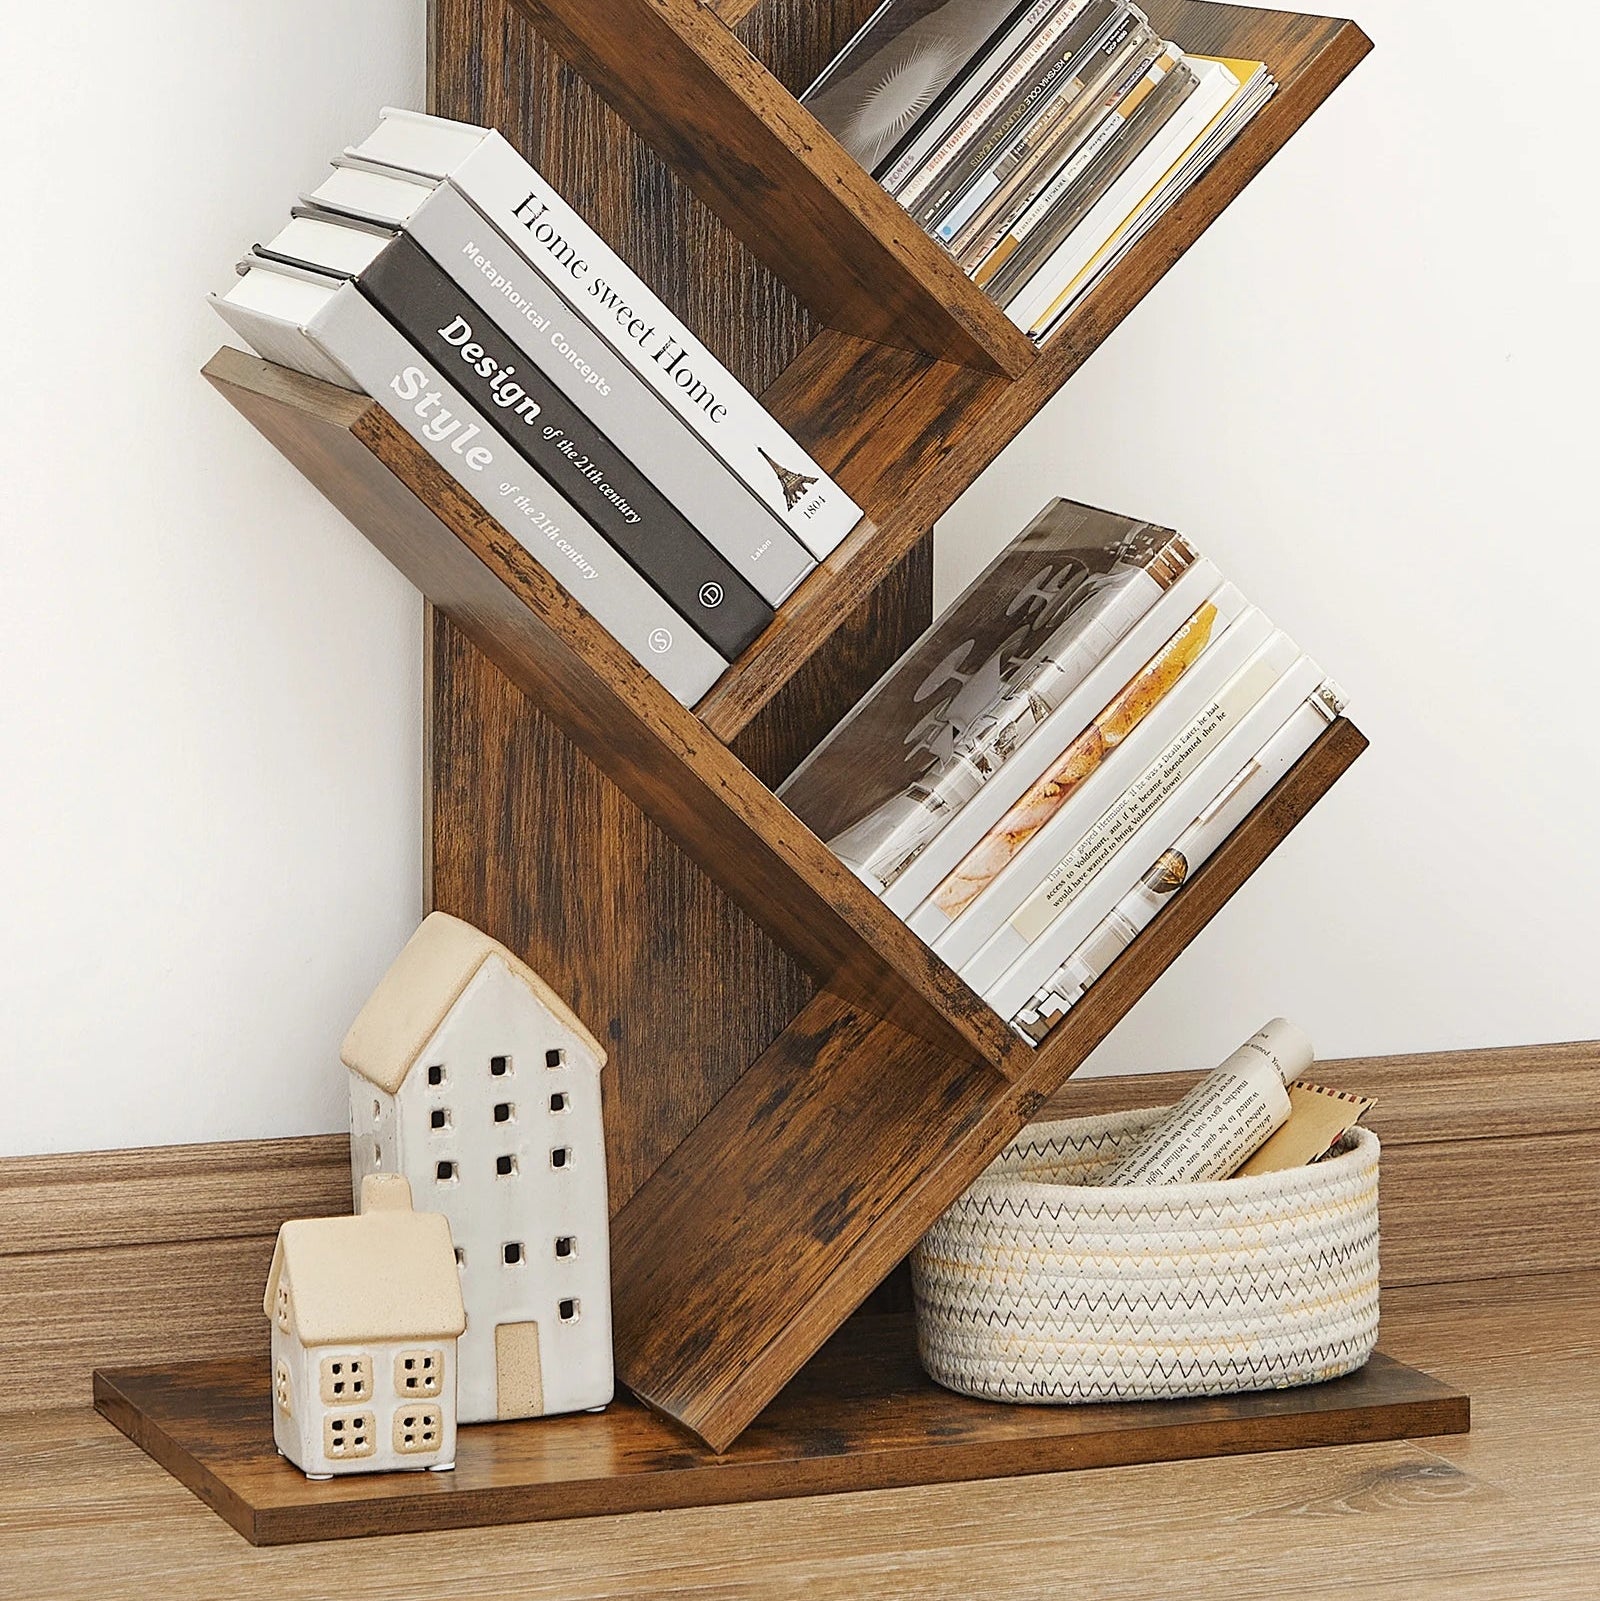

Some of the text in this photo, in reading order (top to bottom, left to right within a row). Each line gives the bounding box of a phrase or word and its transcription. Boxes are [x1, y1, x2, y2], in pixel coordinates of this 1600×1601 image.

[1038, 58, 1065, 86] KEYSHIA
[1023, 86, 1041, 105] COLE
[1001, 103, 1026, 130] CALLING
[990, 128, 1003, 140] ALL
[969, 139, 993, 167] HEARTS
[462, 241, 611, 396] Metaphorical Concepts
[511, 191, 726, 423] Home sweet Home
[437, 315, 640, 523] Design of the 21th century
[389, 366, 598, 578] Style of the 21th century
[750, 540, 772, 561] Lakon
[1073, 829, 1098, 854] gasped
[1134, 780, 1146, 790] he
[1144, 768, 1158, 780] was
[1161, 744, 1181, 763] Death
[1179, 726, 1199, 743] Eater,
[1196, 716, 1207, 726] he
[1206, 702, 1219, 717] had
[1046, 880, 1065, 900] access
[1066, 870, 1074, 878] to
[1073, 836, 1109, 868] Voldemort,
[1109, 819, 1122, 834] and
[1128, 803, 1138, 813] he
[1138, 778, 1162, 802] became
[1163, 736, 1201, 778] disenchanted
[1201, 722, 1216, 737] then
[1215, 711, 1225, 721] he
[1052, 885, 1073, 906] would
[1070, 872, 1087, 888] have
[1086, 847, 1109, 872] wanted
[1108, 842, 1116, 850] to
[1114, 824, 1133, 842] bring
[1130, 793, 1163, 824] Voldemort
[1218, 1074, 1236, 1092] never
[1222, 1080, 1248, 1104] matches
[1191, 1092, 1220, 1118] formerly
[1206, 1104, 1222, 1122] gave
[1235, 1091, 1259, 1117] wanted
[1244, 1102, 1266, 1128] rubbed
[1179, 1118, 1195, 1130] had
[1191, 1121, 1206, 1137] such
[1218, 1123, 1228, 1133] be
[1227, 1114, 1236, 1123] to
[1244, 1114, 1270, 1142] delicious
[1169, 1130, 1181, 1140] the
[1200, 1133, 1216, 1151] quite
[1233, 1126, 1243, 1138] the
[1132, 1140, 1170, 1179] grandmother
[1160, 1143, 1188, 1169] brilliant
[1185, 1152, 1200, 1166] sure
[1213, 1139, 1231, 1159] whole
[1228, 1142, 1243, 1160] roast
[1145, 1168, 1163, 1185] light
[1177, 1166, 1185, 1177] of
[1190, 1159, 1212, 1182] bundle
